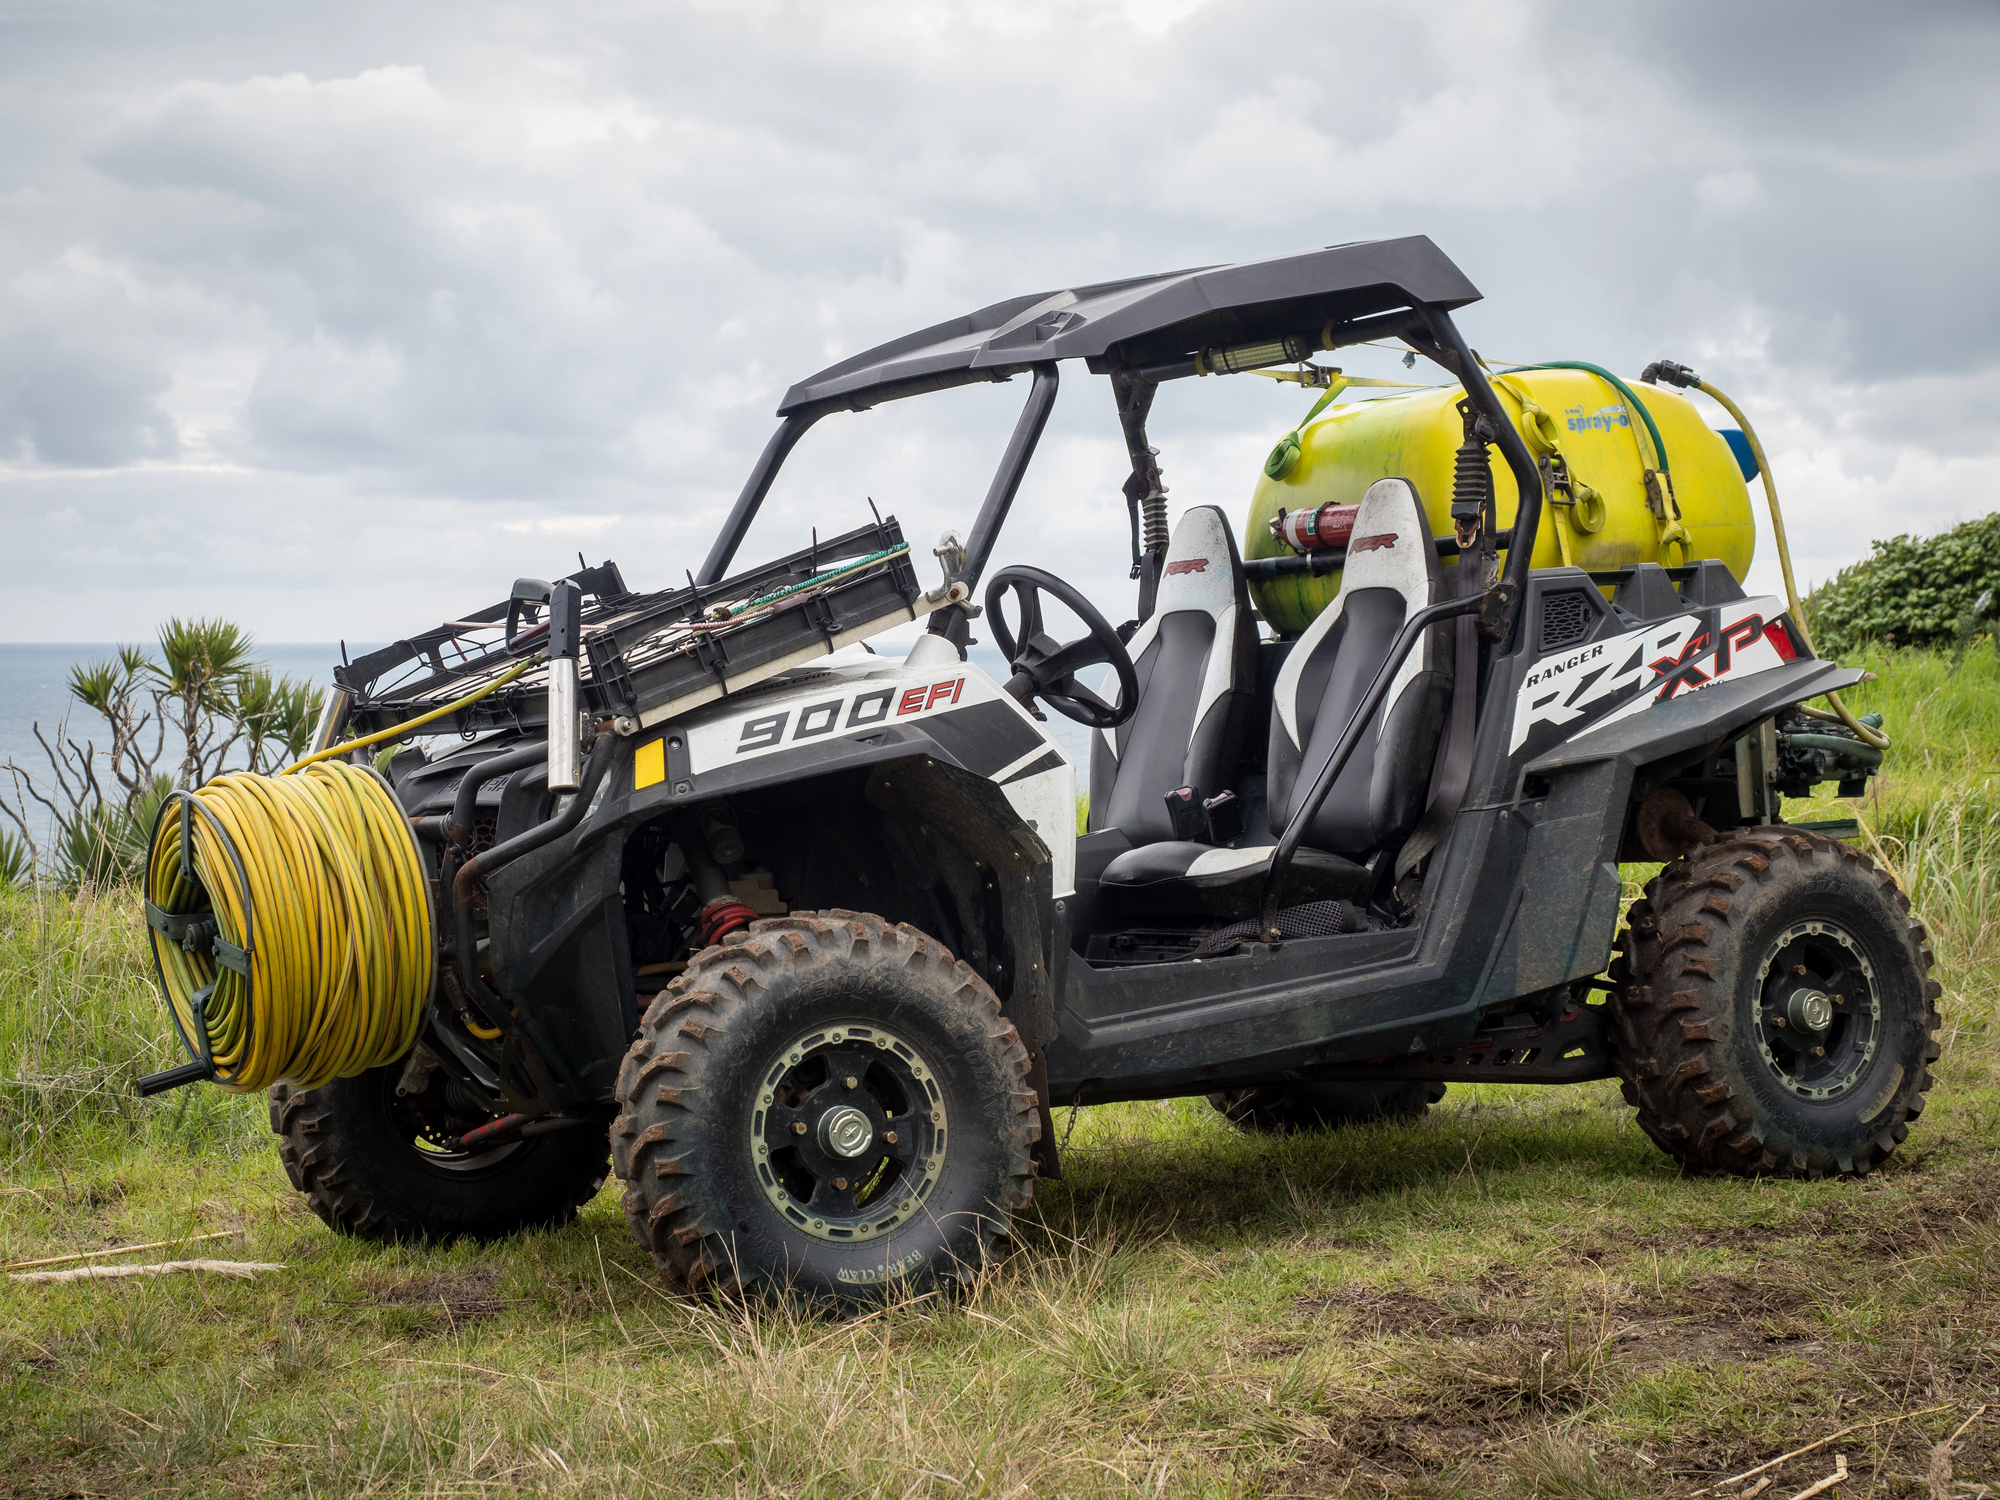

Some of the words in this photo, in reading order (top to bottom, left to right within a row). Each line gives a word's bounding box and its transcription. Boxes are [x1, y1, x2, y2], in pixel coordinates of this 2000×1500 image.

[1567, 414, 1631, 434] spray-o
[1348, 533, 1399, 556] RZR
[1163, 558, 1209, 578] RZR
[1526, 644, 1604, 688] RANGER
[1648, 613, 1764, 700] XP
[736, 686, 897, 754] 900
[896, 677, 966, 716] EFI
[837, 1267, 876, 1280] CLAW
